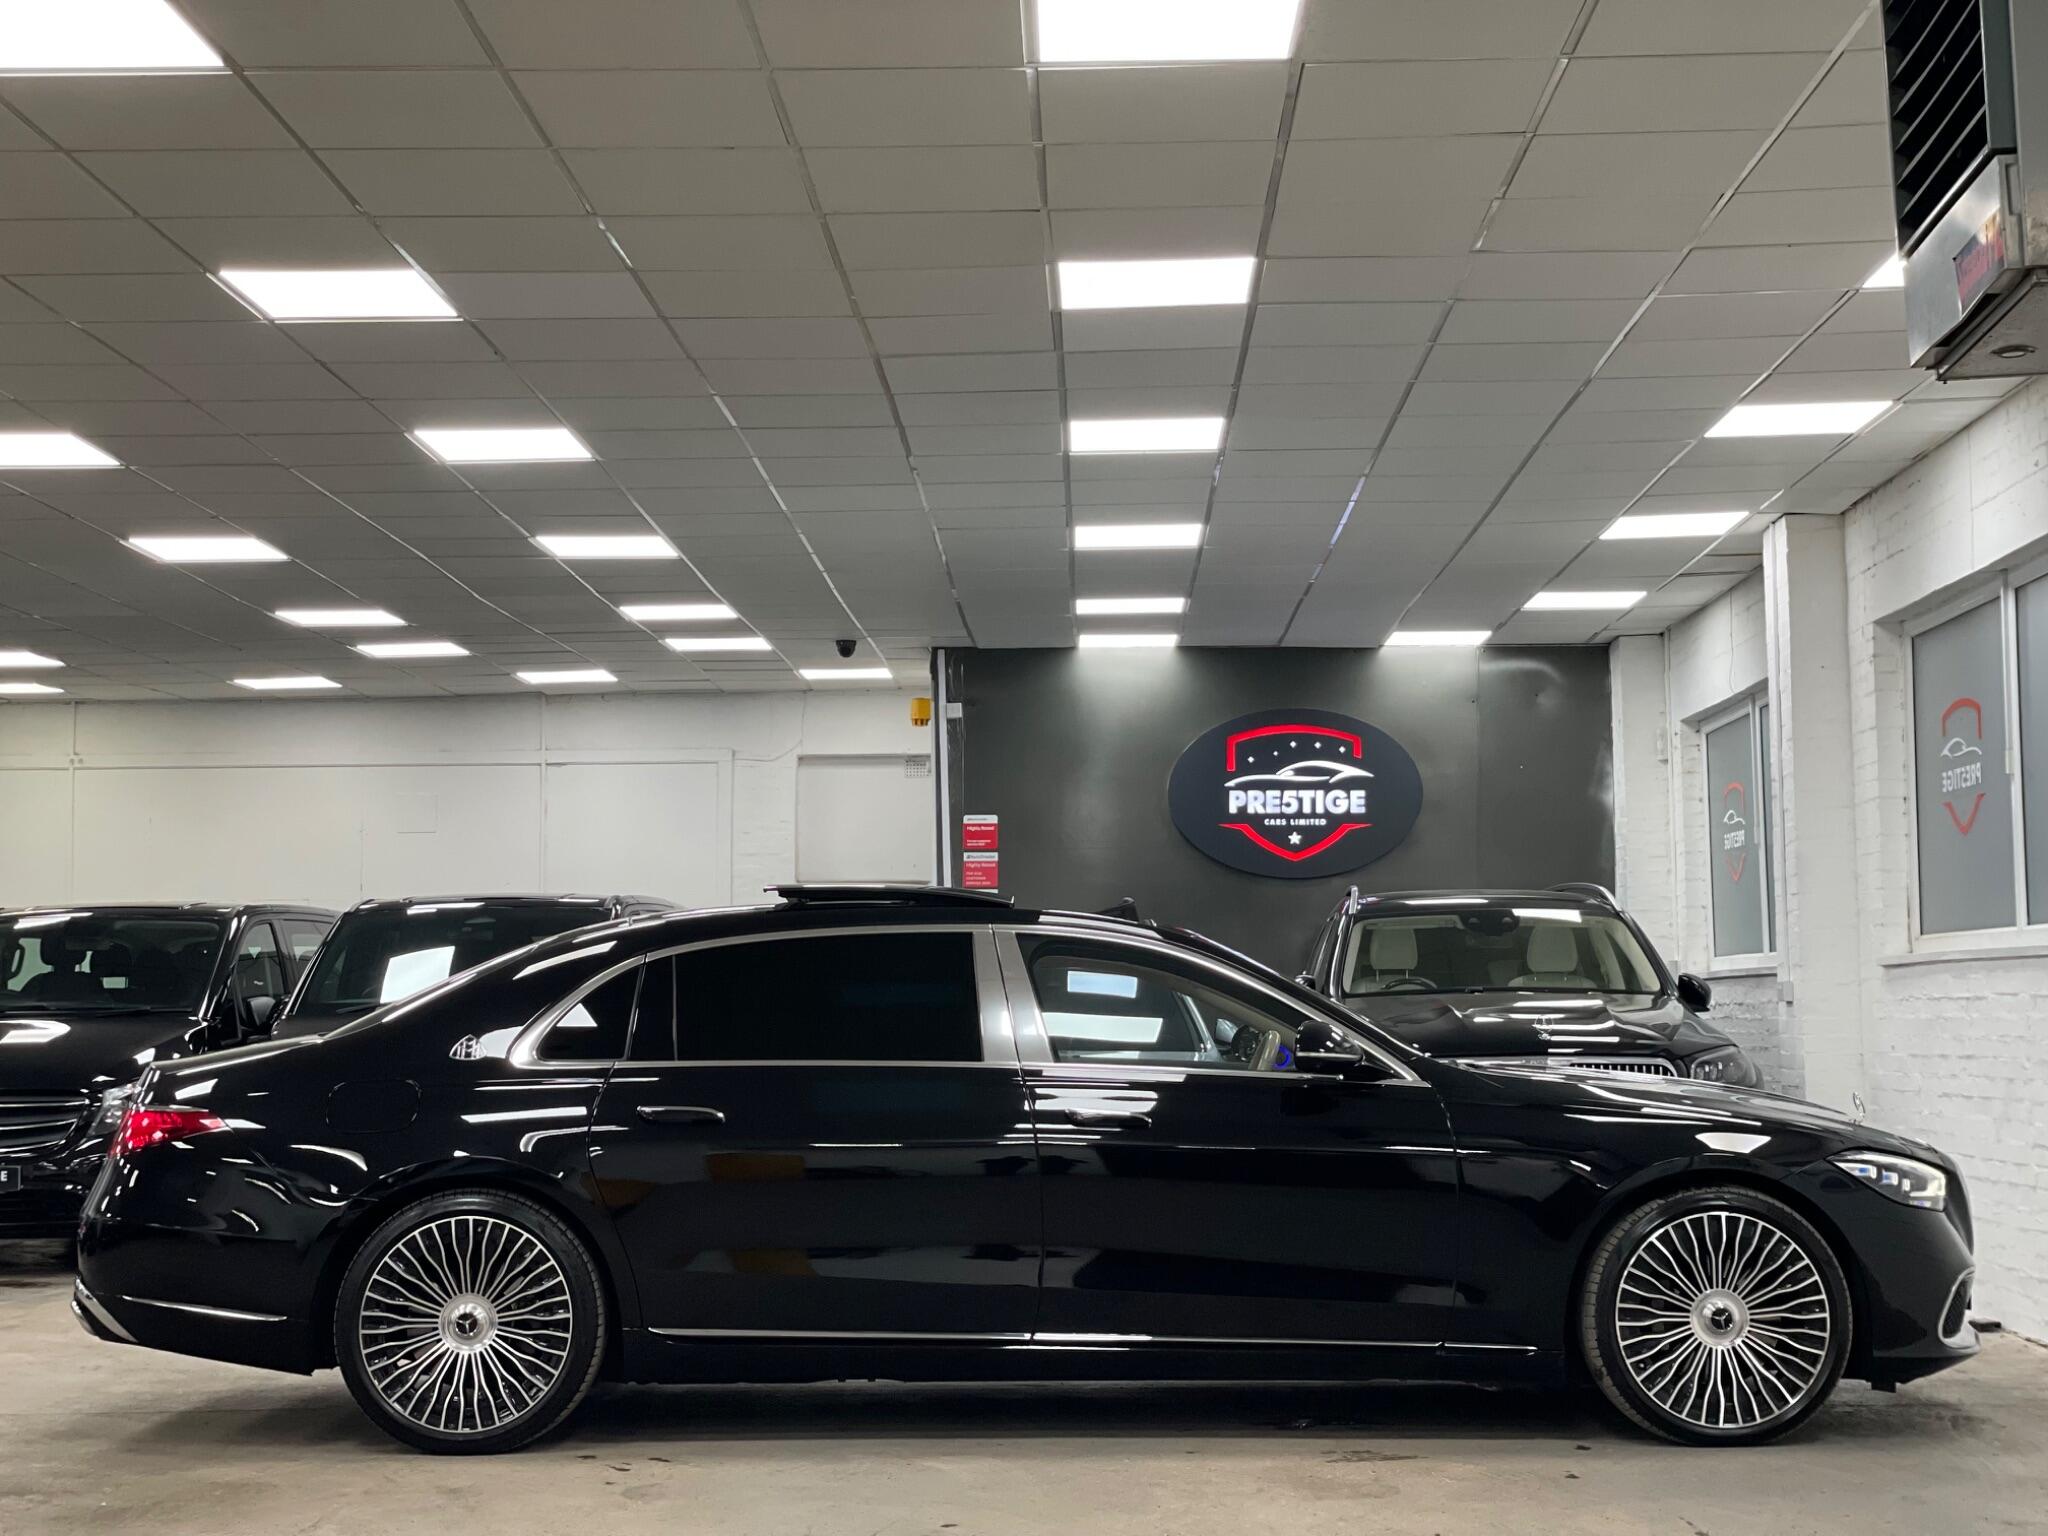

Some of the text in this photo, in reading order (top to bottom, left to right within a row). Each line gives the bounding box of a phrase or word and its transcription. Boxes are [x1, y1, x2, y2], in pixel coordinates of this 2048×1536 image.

[1228, 789, 1366, 814] PRE5TIGE
[1264, 818, 1327, 826] CARS LIMITED
